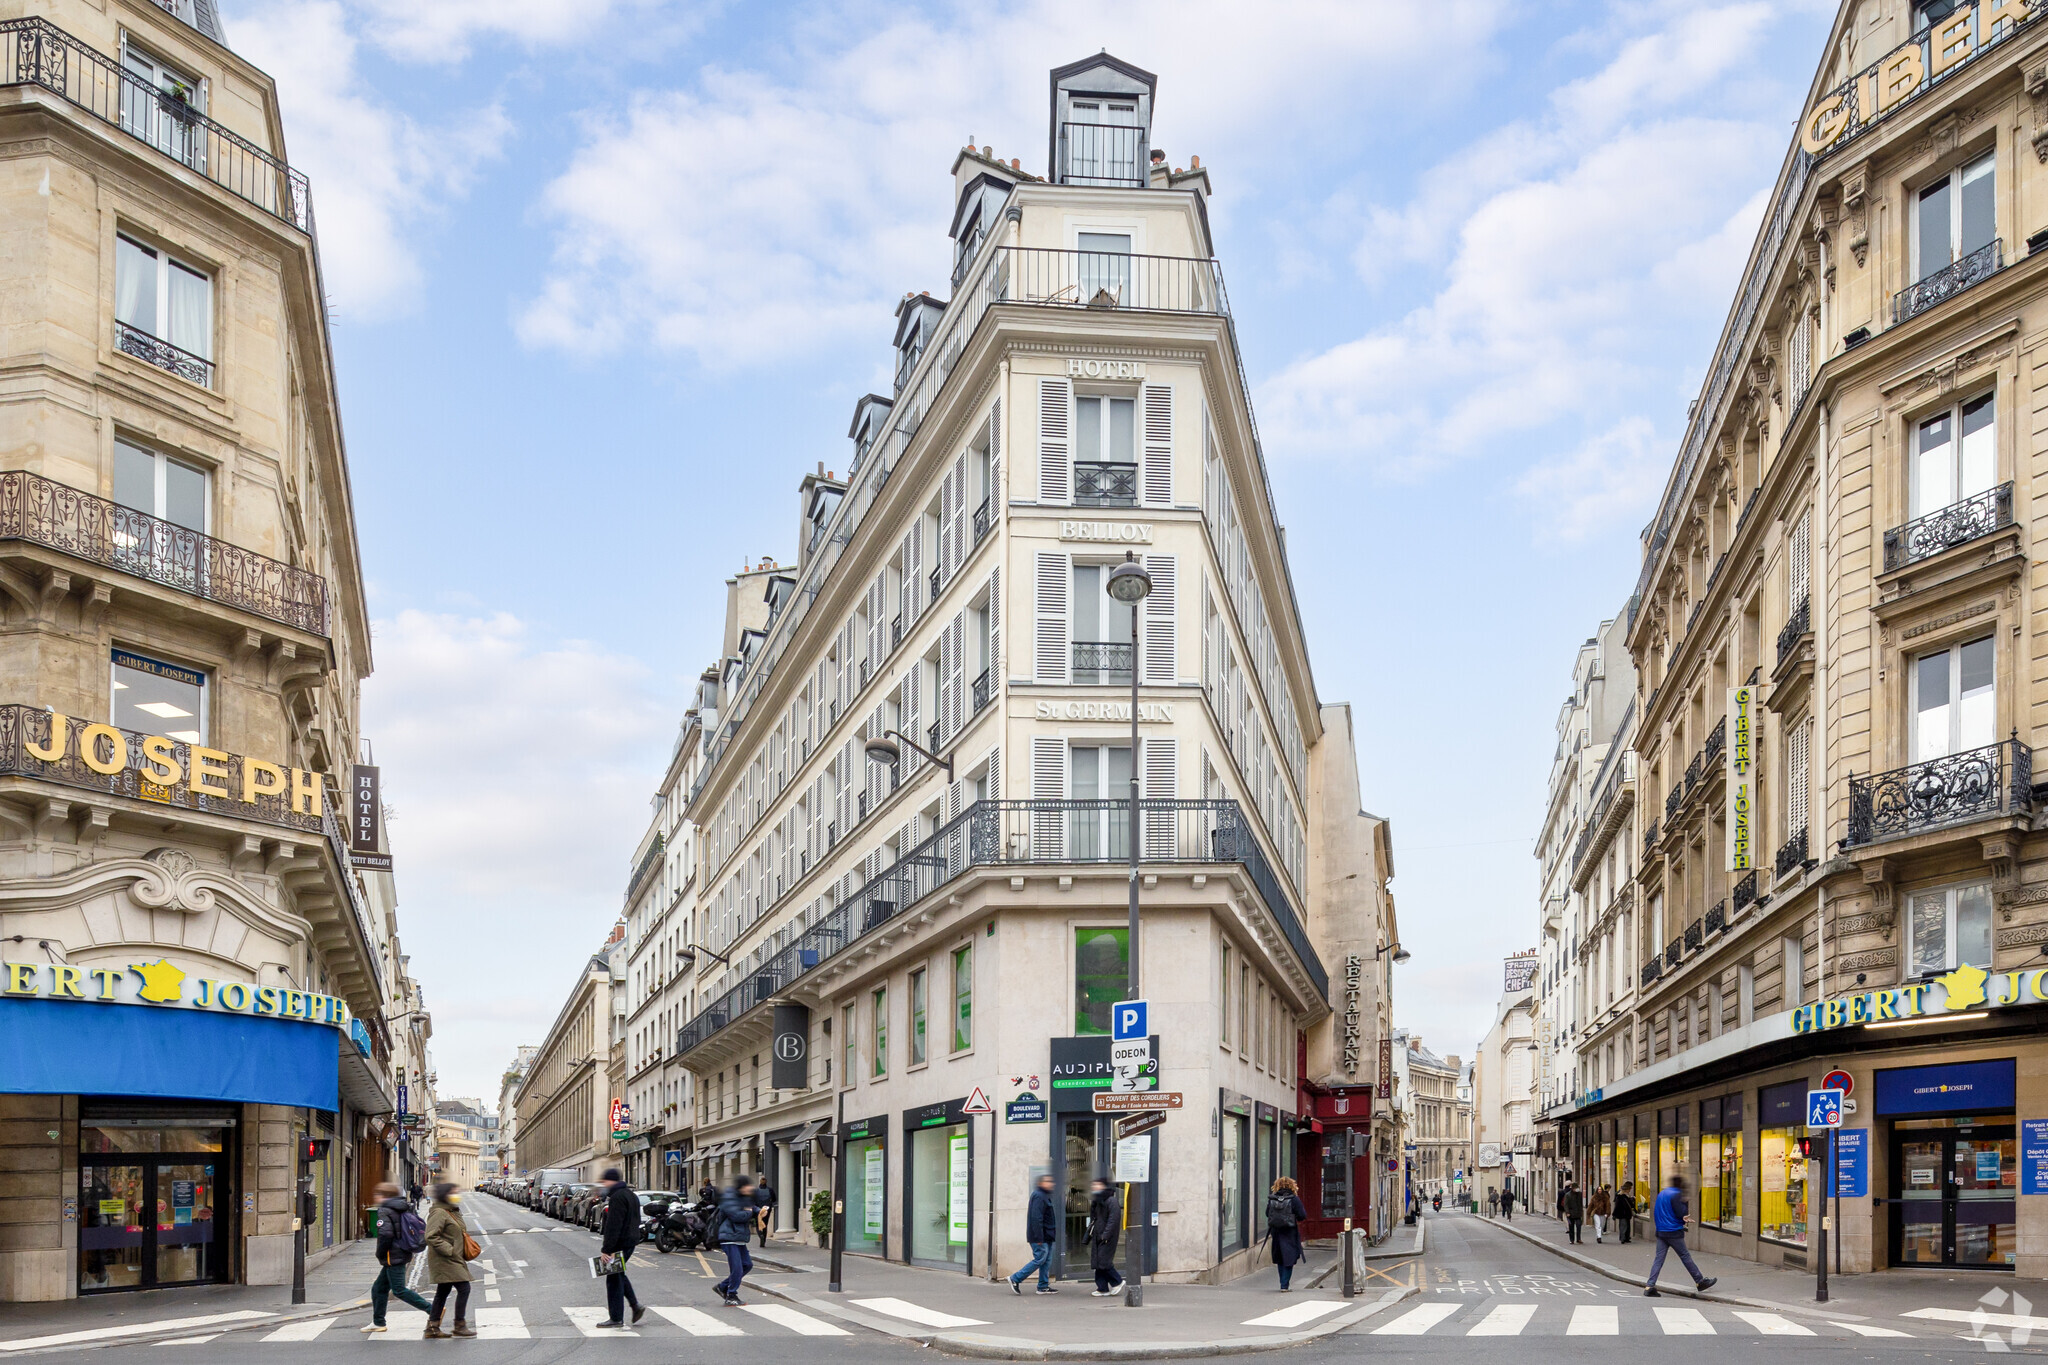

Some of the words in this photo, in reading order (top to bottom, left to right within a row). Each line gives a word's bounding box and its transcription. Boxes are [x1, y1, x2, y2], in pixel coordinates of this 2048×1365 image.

[1067, 359, 1145, 379] HOTEL
[1061, 520, 1153, 541] BELLOY
[118, 655, 157, 673] GIBERT
[161, 666, 197, 684] JOSEPH
[1037, 701, 1058, 718] St
[1065, 702, 1173, 721] GERMAIN
[1734, 688, 1750, 775] GIBERT
[24, 711, 323, 817] JOSEPH
[360, 776, 372, 841] HOTEL
[1734, 784, 1750, 870] JOSEPH
[367, 857, 391, 866] BELLOY
[193, 979, 347, 1025] JOSEPH
[1345, 954, 1361, 1074] RESTAURANT
[1790, 984, 1931, 1035] GIBERT
[1122, 1009, 1139, 1034] P
[782, 1036, 799, 1058] B
[1115, 1048, 1146, 1059] ODEON
[1541, 1022, 1551, 1079] HOTEL
[1913, 1086, 1938, 1094] GIBERT
[1948, 1084, 1973, 1092] JOSEPH
[612, 1104, 621, 1129] TABAC
[1458, 1279, 1601, 1289] PIETON
